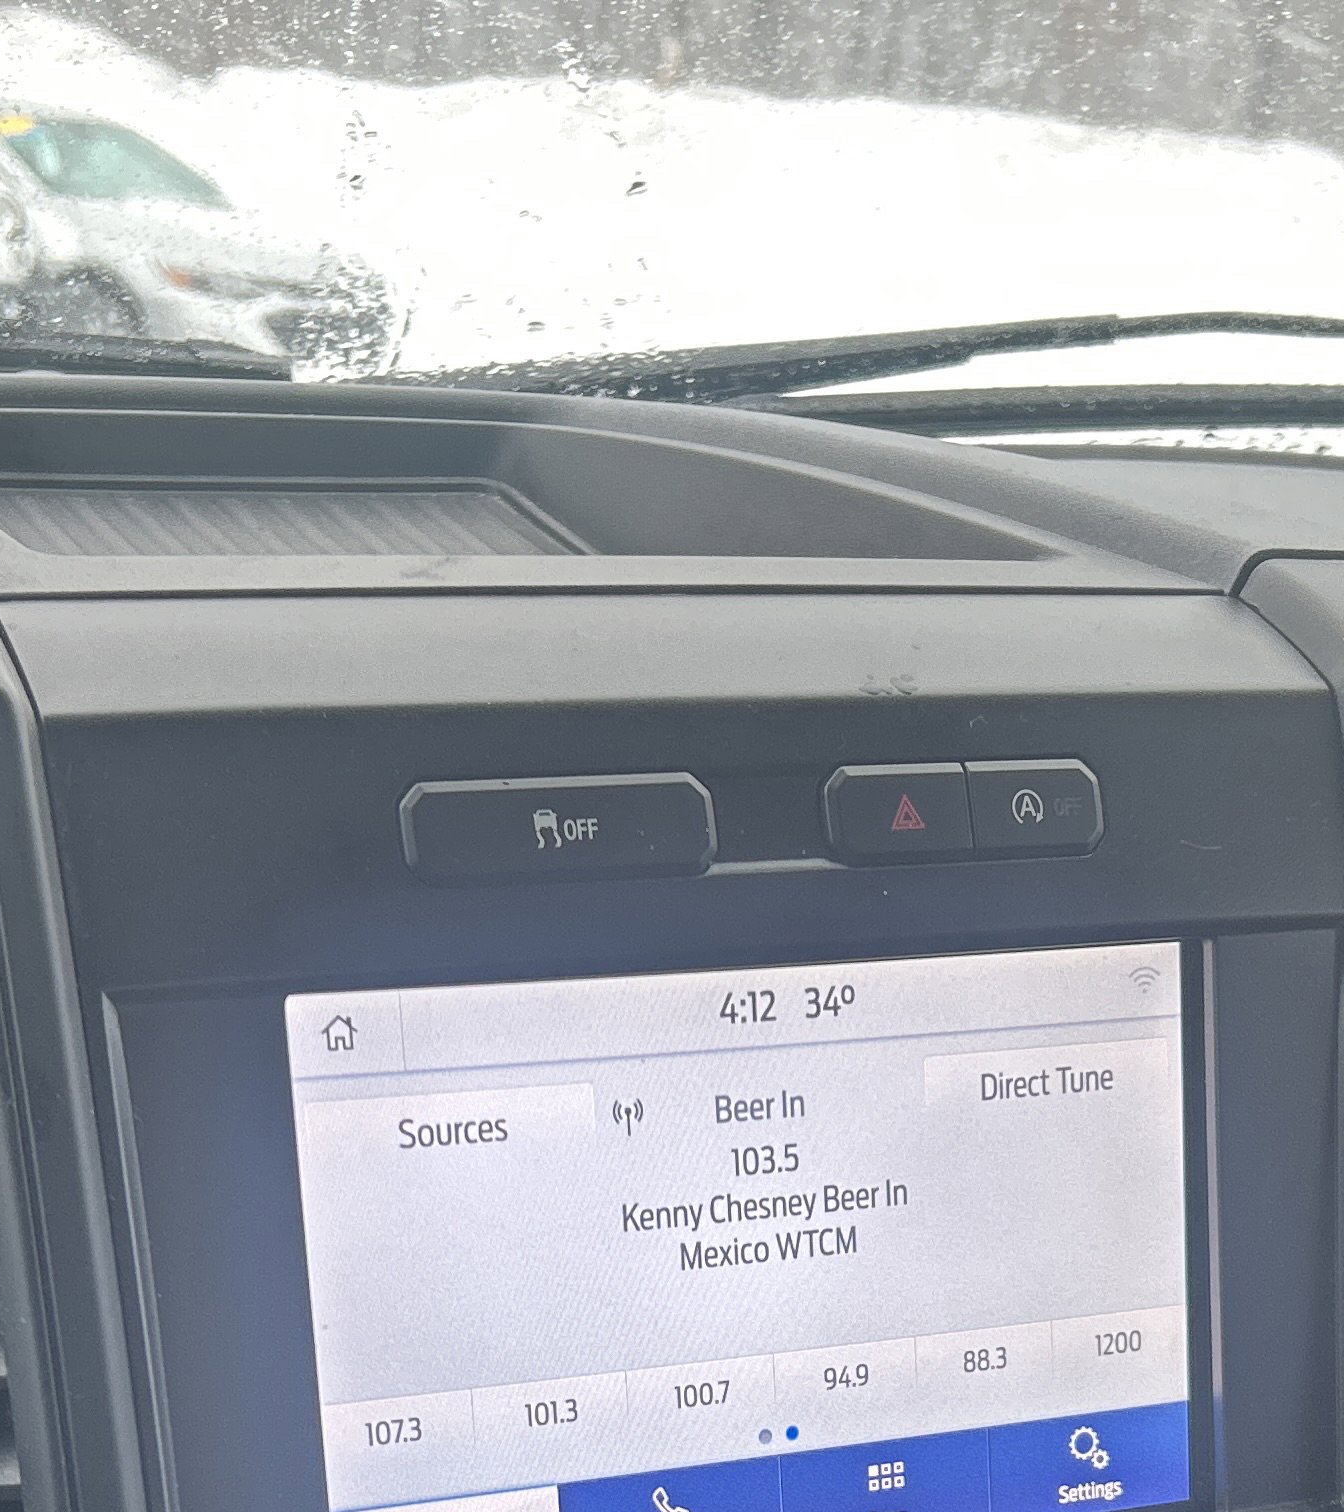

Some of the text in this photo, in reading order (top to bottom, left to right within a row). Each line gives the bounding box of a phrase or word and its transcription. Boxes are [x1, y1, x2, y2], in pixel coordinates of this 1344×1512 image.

[563, 818, 599, 841] OFF
[719, 989, 777, 1025] 4:12
[981, 1066, 1114, 1101] Direct Tune
[714, 1089, 805, 1124] Beer In
[398, 1118, 509, 1149] Sources
[730, 1142, 799, 1177] 103.5
[622, 1178, 908, 1233] Kenny Chesney Beer In
[679, 1225, 857, 1271] Mexico WTCM
[1094, 1329, 1142, 1357] 1200
[963, 1346, 1007, 1373] 88.3
[823, 1363, 869, 1391] 94.9
[674, 1379, 730, 1410] 100.7
[524, 1398, 578, 1428] 101.3
[364, 1417, 422, 1447] 107.3
[1058, 1481, 1124, 1504] Settings
